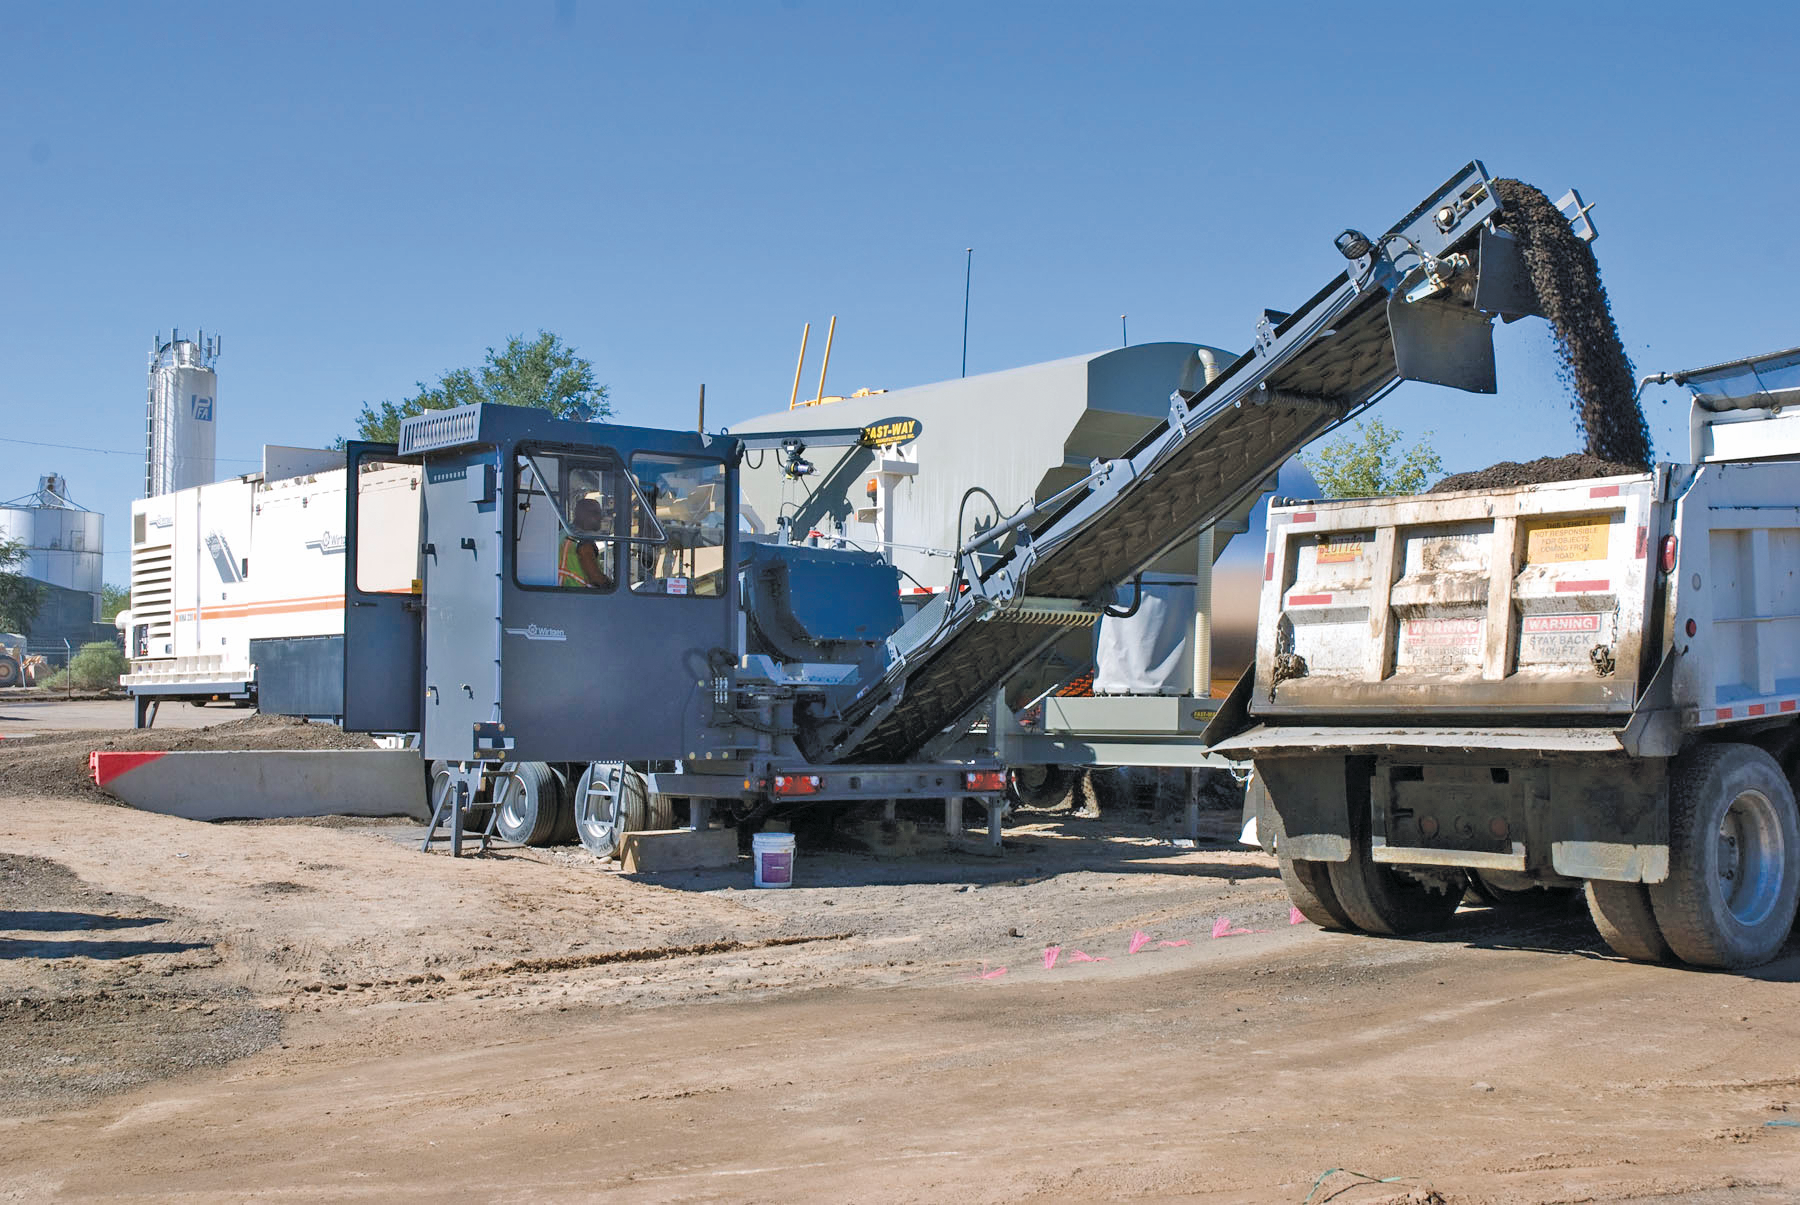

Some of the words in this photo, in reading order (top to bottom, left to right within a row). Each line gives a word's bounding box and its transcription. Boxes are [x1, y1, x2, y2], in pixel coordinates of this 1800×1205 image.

[864, 420, 916, 441] FAST-WAY
[1563, 519, 1593, 527] VEHICLE
[1535, 530, 1549, 538] NOT
[1550, 527, 1597, 537] RESPONSIBLE
[1541, 545, 1568, 553] COMING
[1570, 543, 1590, 551] FROM
[1411, 620, 1478, 635] WARNING
[1529, 617, 1593, 630] WARNING
[539, 627, 565, 636] Wirtgen
[1530, 635, 1556, 646] STAY
[1560, 634, 1591, 645] BACK
[1542, 646, 1557, 656] 100
